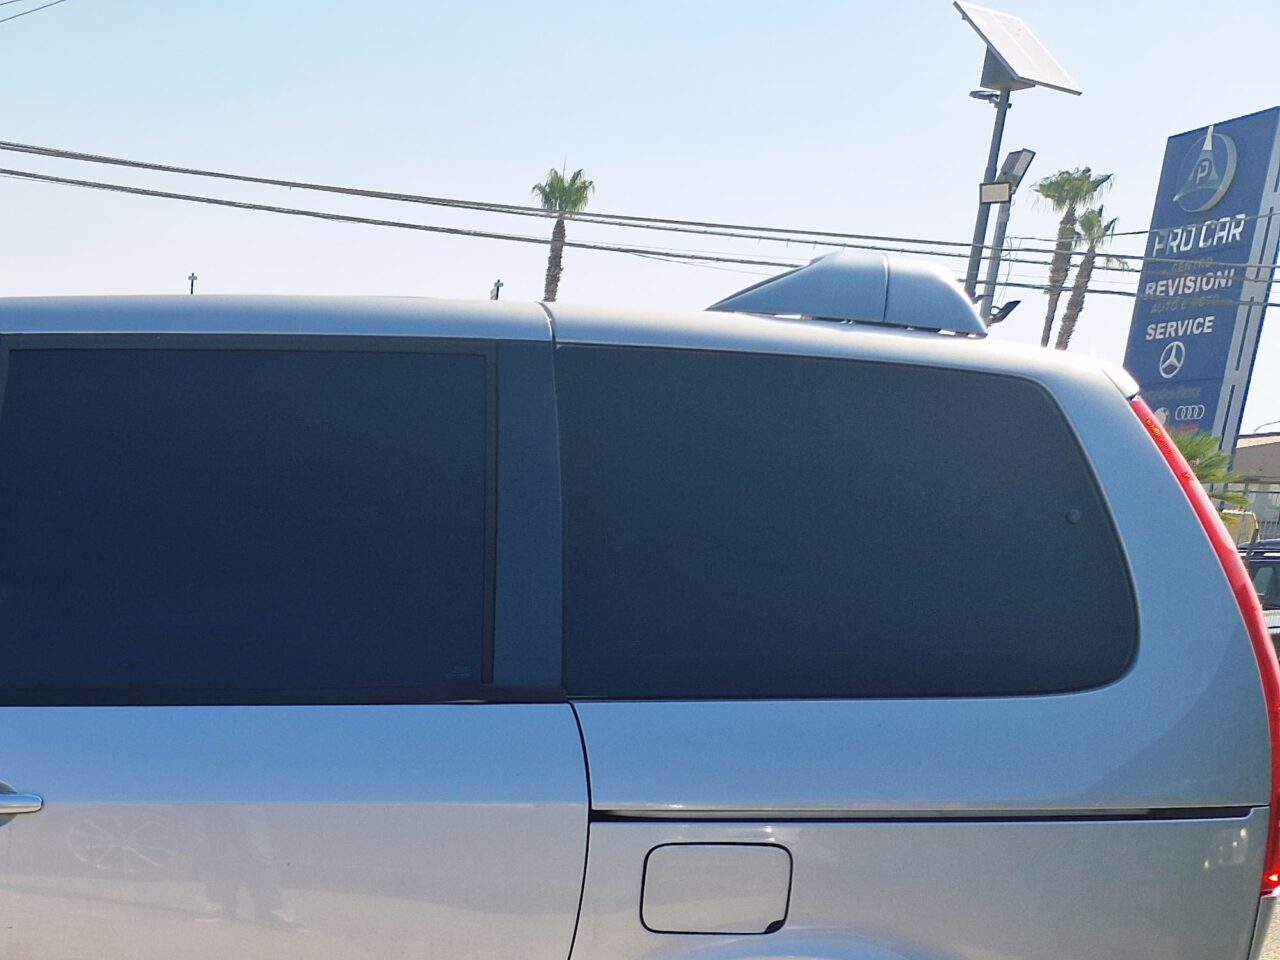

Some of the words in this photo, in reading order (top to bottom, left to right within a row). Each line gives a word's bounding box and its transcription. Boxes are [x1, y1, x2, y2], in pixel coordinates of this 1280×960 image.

[1152, 224, 1196, 257] PRO
[1198, 213, 1246, 249] CAR
[1145, 268, 1235, 297] REVISIONI
[1145, 315, 1215, 341] SERVICE
